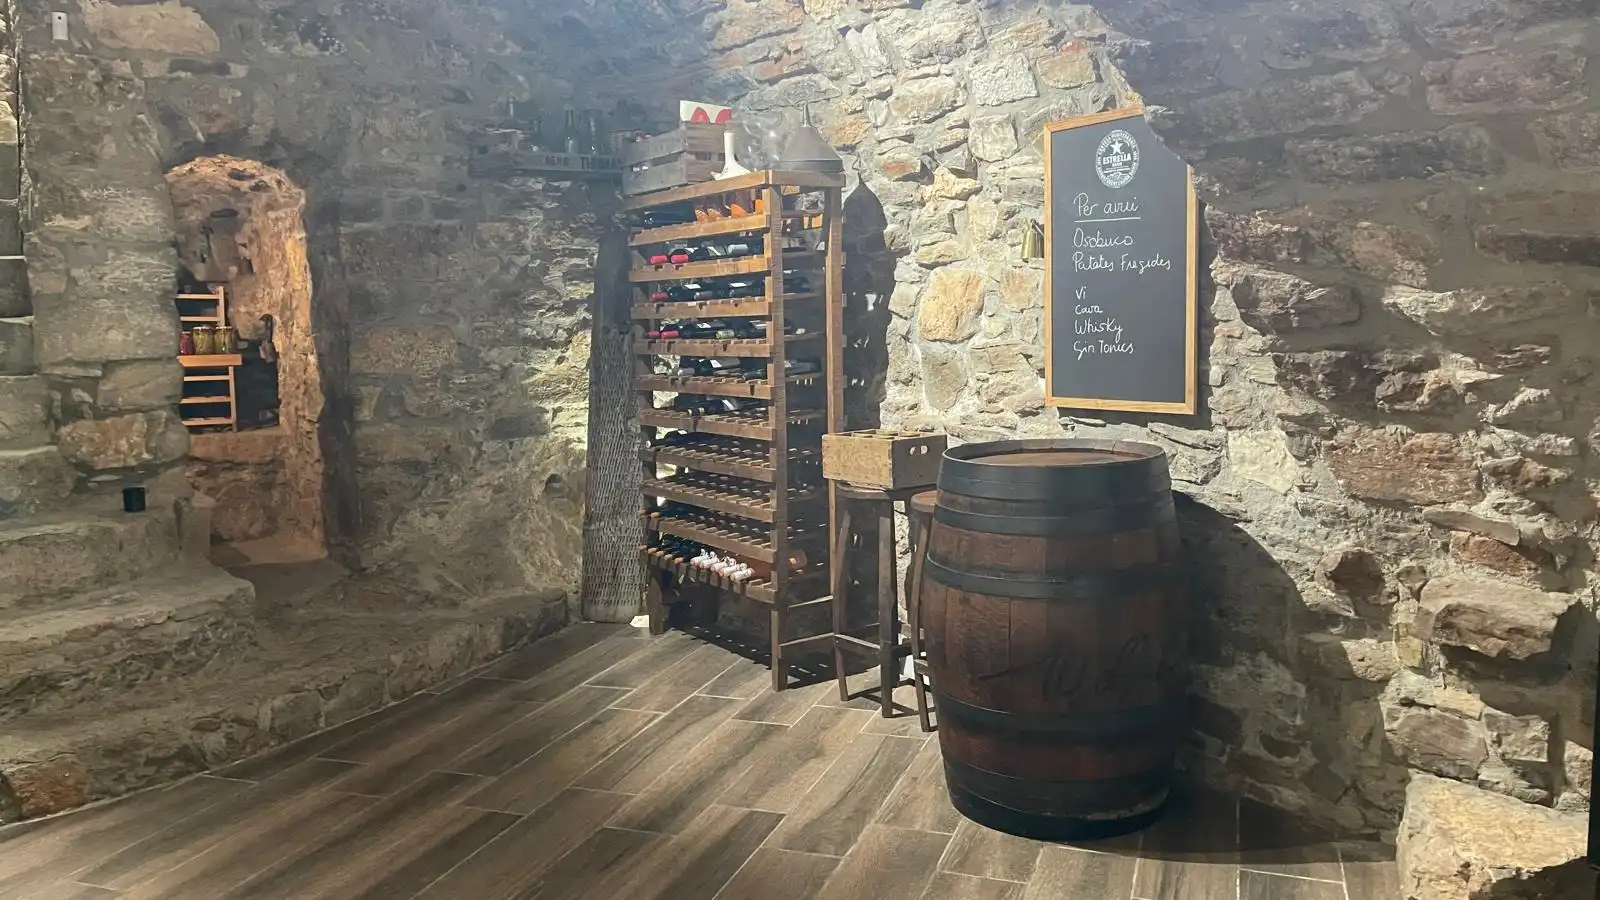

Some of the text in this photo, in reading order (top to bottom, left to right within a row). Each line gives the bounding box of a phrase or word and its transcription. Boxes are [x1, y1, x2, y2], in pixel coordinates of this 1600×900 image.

[1102, 153, 1132, 165] ESTRELLA
[1073, 192, 1099, 216] Per
[1073, 227, 1134, 248] Osobuco
[1072, 251, 1114, 273] Patates
[1073, 339, 1134, 361] Gin Tonics
